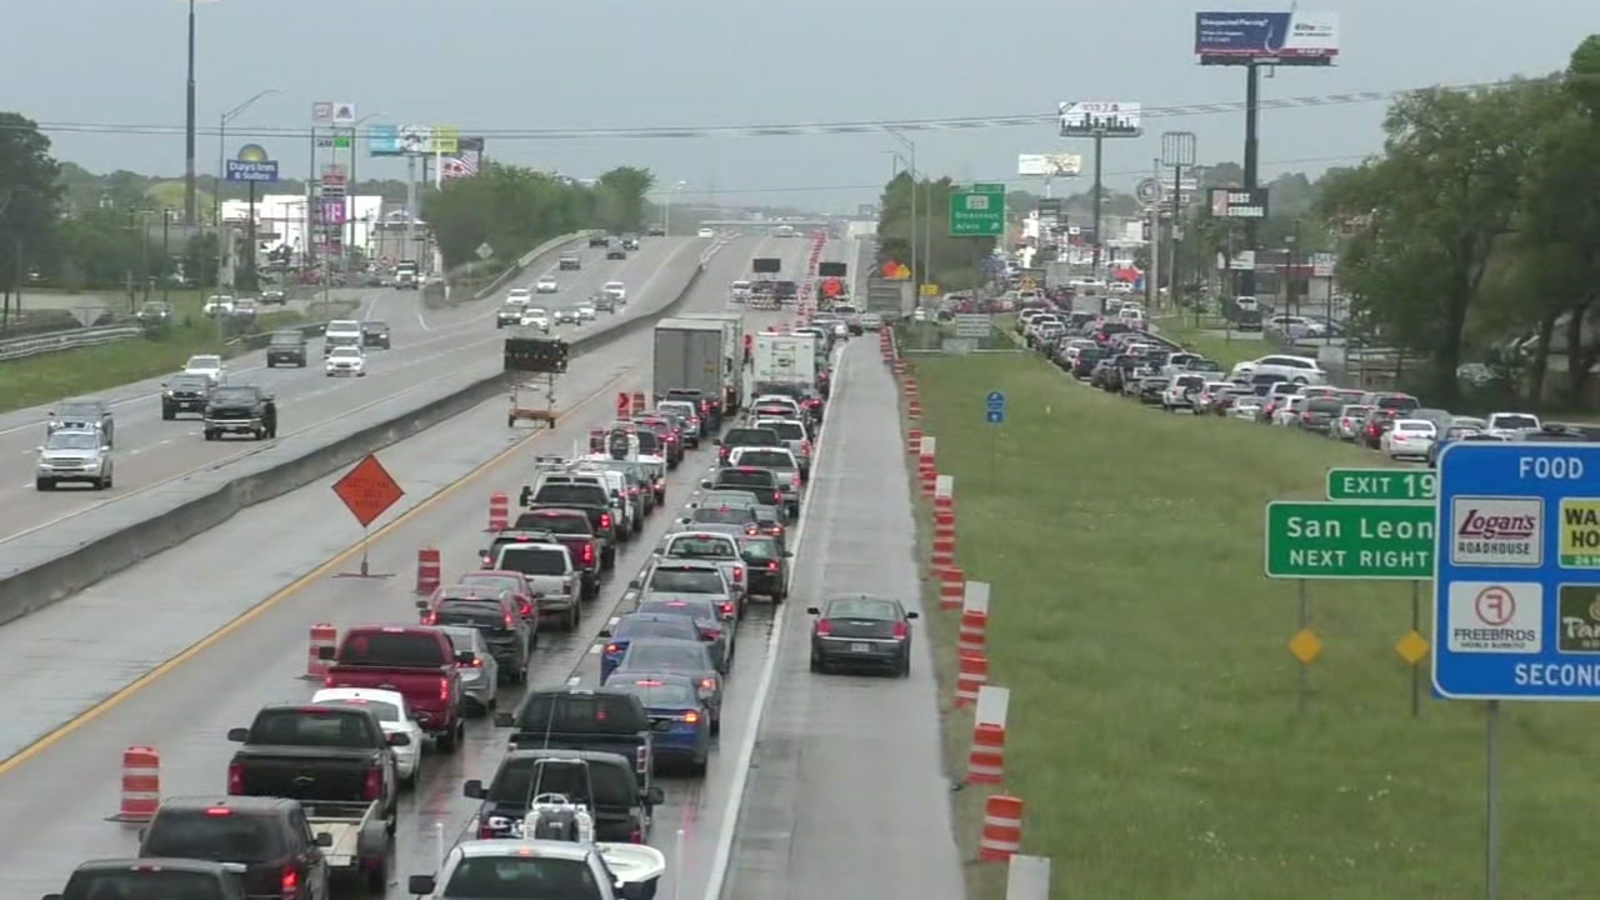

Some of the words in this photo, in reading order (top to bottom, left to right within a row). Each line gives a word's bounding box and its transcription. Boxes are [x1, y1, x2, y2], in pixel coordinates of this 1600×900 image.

[229, 161, 255, 173] Days
[257, 163, 275, 171] Inn
[1519, 456, 1584, 479] FOOD
[1343, 477, 1391, 493] EXIT
[1404, 474, 1437, 498] 19
[1286, 516, 1341, 538] San
[1360, 518, 1433, 539] Leon
[1458, 509, 1537, 540] Logan's
[1290, 549, 1347, 567] NEXT
[1360, 550, 1429, 567] RIGHT
[1458, 541, 1531, 555] ROADHOUSE
